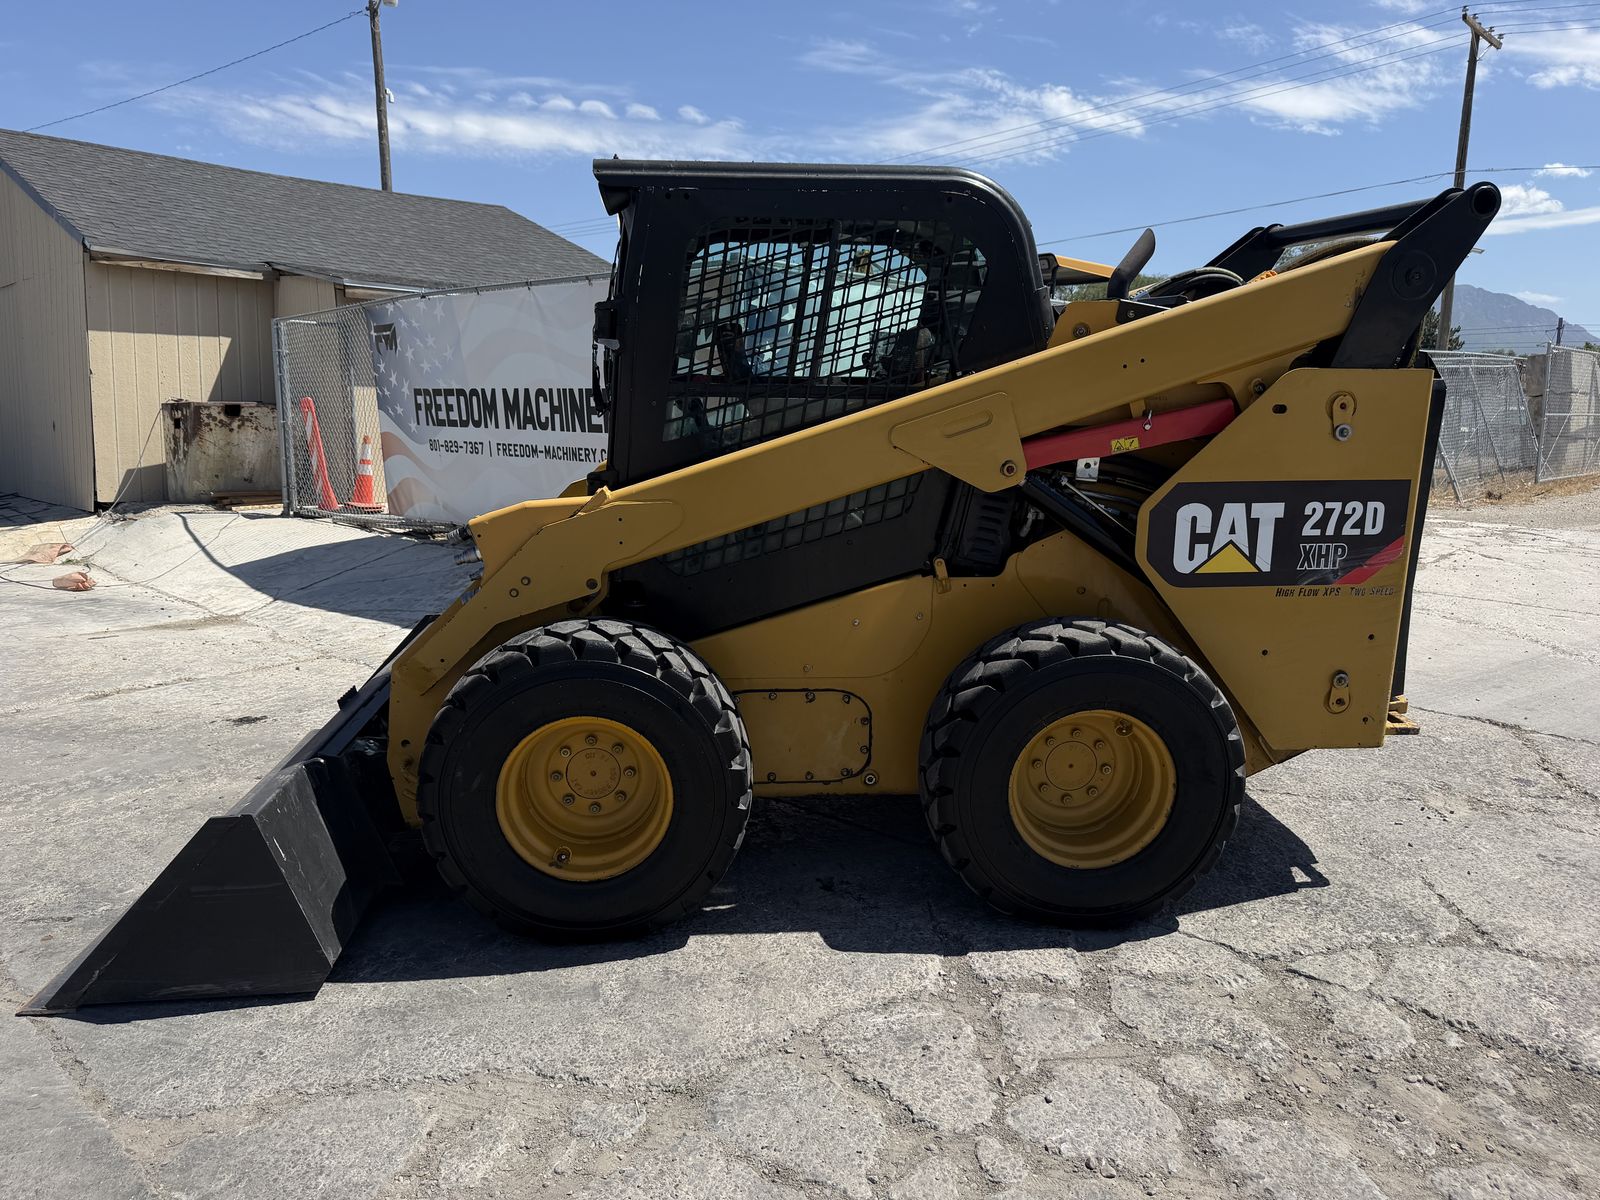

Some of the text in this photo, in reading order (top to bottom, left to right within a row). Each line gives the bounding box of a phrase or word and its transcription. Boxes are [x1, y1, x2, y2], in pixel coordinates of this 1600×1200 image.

[413, 387, 500, 429] FREEDOM
[428, 438, 485, 455] 801-829-7367
[1301, 501, 1386, 537] 272D
[1173, 502, 1286, 574] CAT
[1296, 543, 1348, 570] XHP
[1322, 586, 1342, 597] XPS
